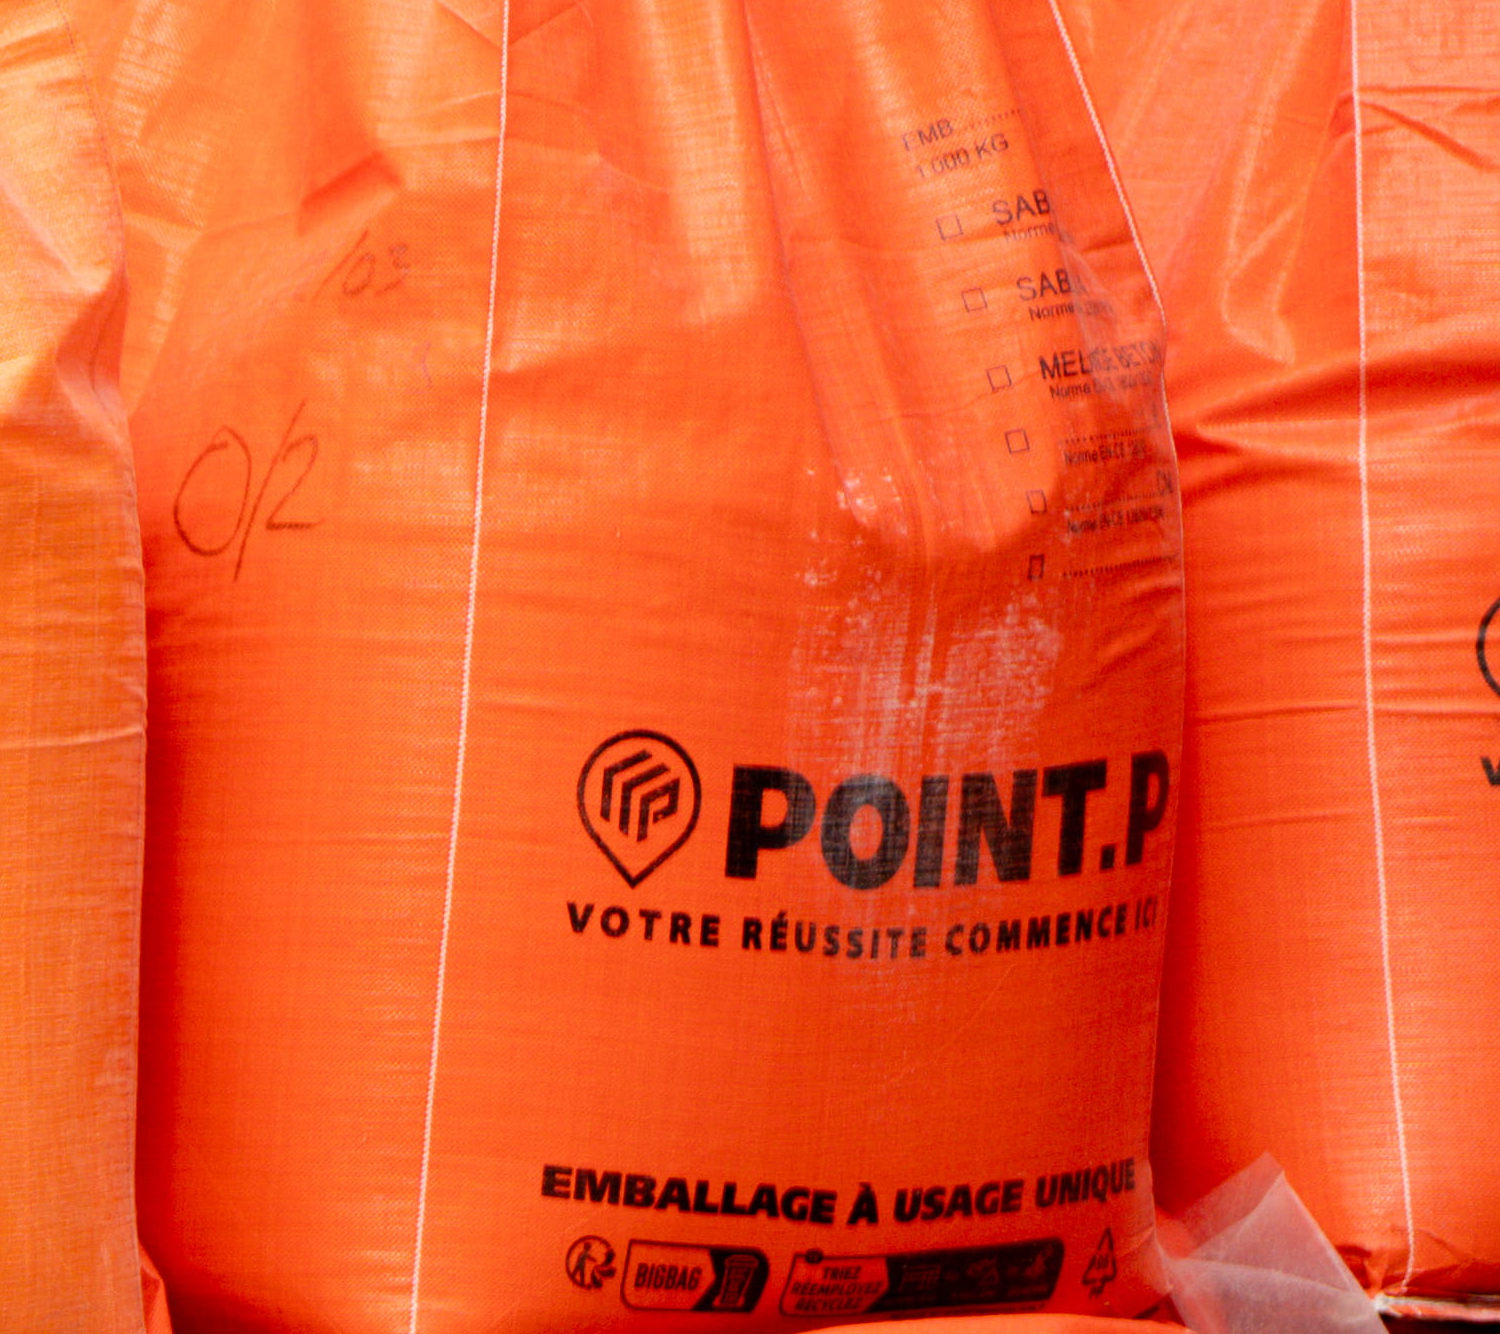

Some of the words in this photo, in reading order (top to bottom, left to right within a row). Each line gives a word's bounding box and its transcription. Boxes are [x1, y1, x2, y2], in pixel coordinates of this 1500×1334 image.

[902, 117, 954, 152] EMB
[974, 132, 1009, 160] KG
[725, 750, 1170, 890] POINT.P
[566, 902, 720, 948] VOTRE
[742, 911, 927, 960] RÉUSSITE
[944, 903, 1128, 955] COMMENCE
[1134, 894, 1158, 931] ICI
[542, 1164, 837, 1225] EMBALLAGE
[846, 1182, 880, 1225] À
[893, 1179, 1024, 1223] USAGE
[1034, 1157, 1136, 1204] UNIQUE
[634, 1262, 702, 1292] BIGBAG
